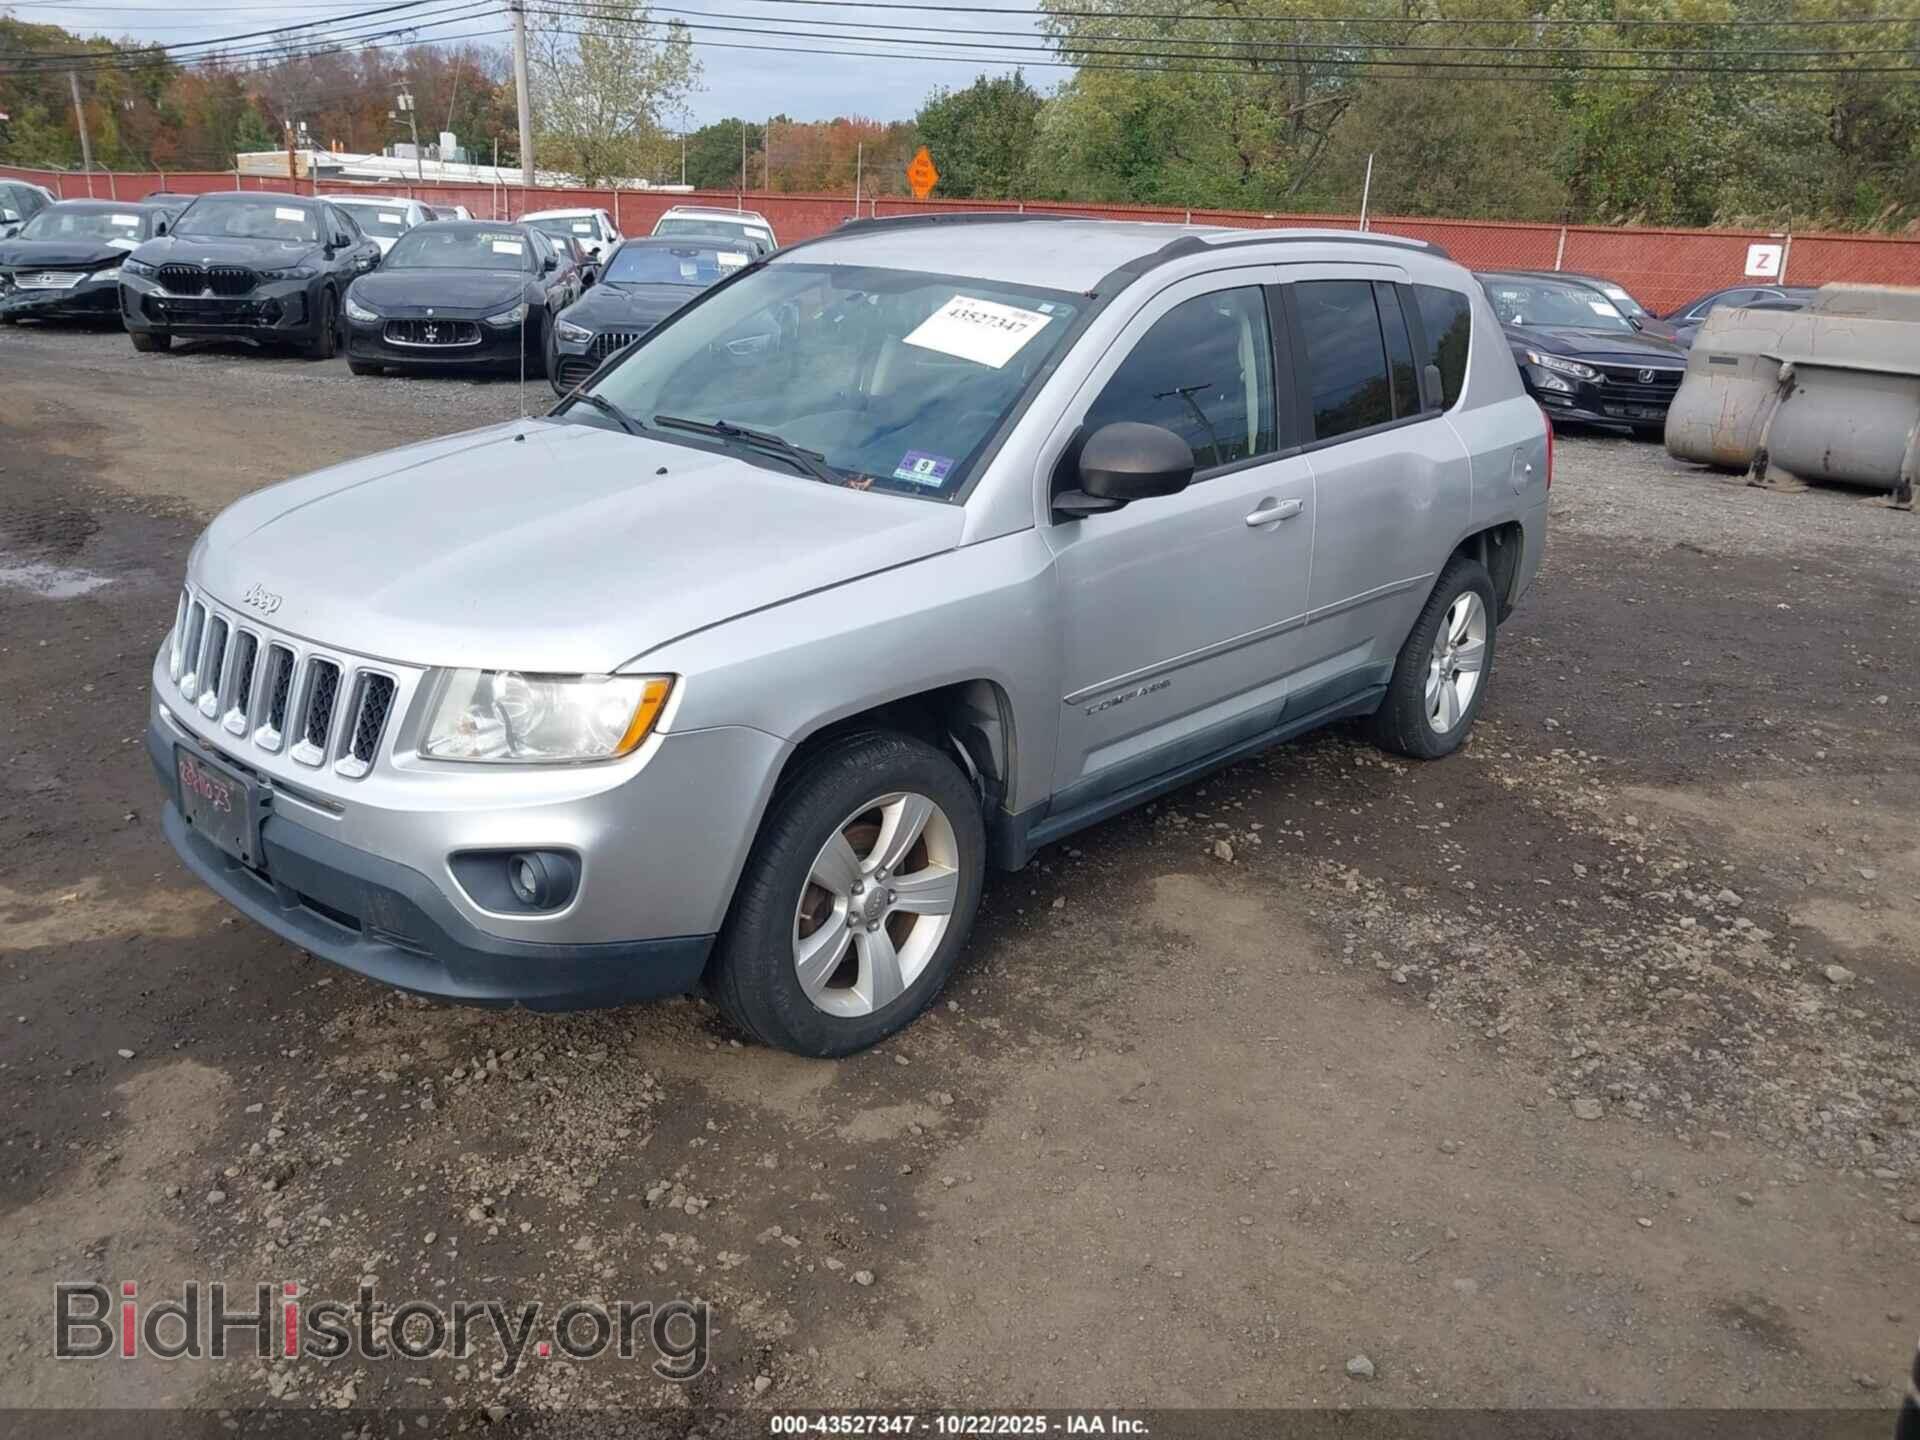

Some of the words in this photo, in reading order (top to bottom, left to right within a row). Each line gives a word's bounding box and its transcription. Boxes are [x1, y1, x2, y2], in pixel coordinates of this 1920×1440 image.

[1756, 253, 1771, 269] Z
[947, 308, 1029, 333] 43527347
[242, 583, 282, 616] Jeep
